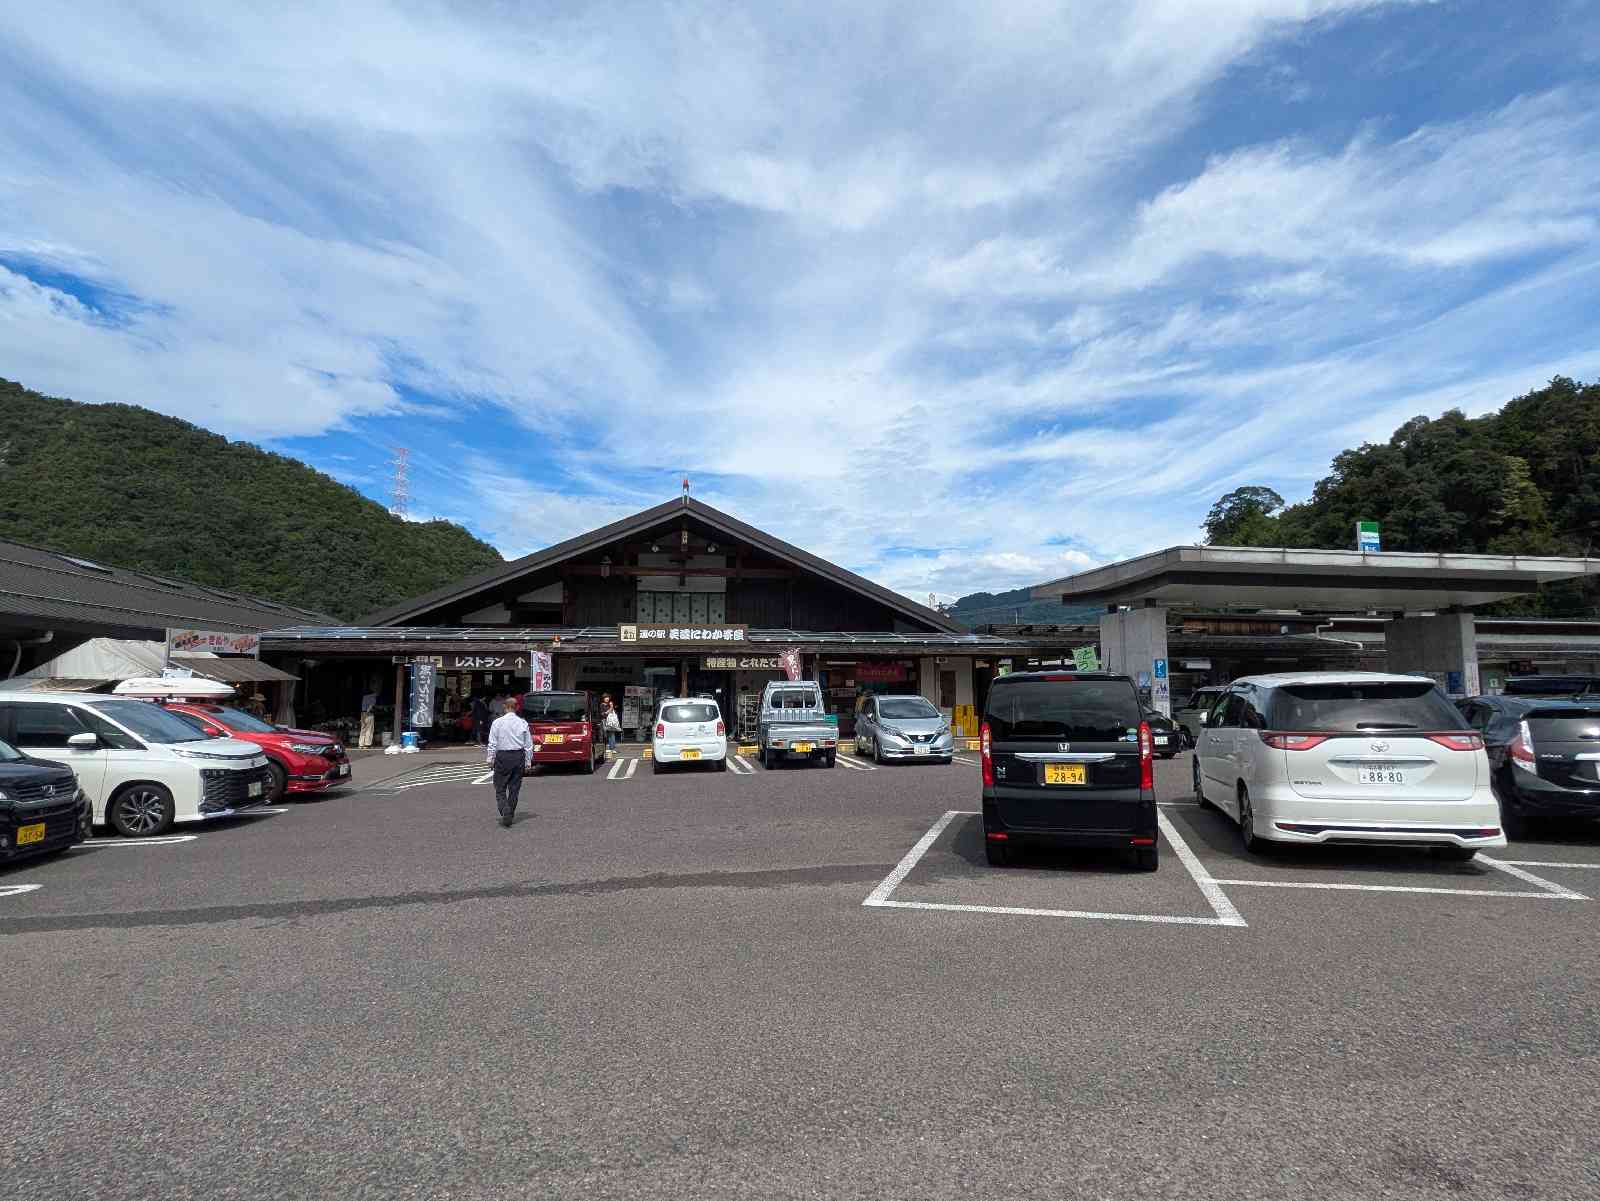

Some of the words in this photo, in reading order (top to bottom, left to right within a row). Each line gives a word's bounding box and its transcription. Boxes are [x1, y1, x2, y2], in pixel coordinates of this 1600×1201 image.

[455, 656, 505, 668] レストラン
[1054, 772, 1083, 783] 28-94
[1369, 771, 1403, 783] 88-80
